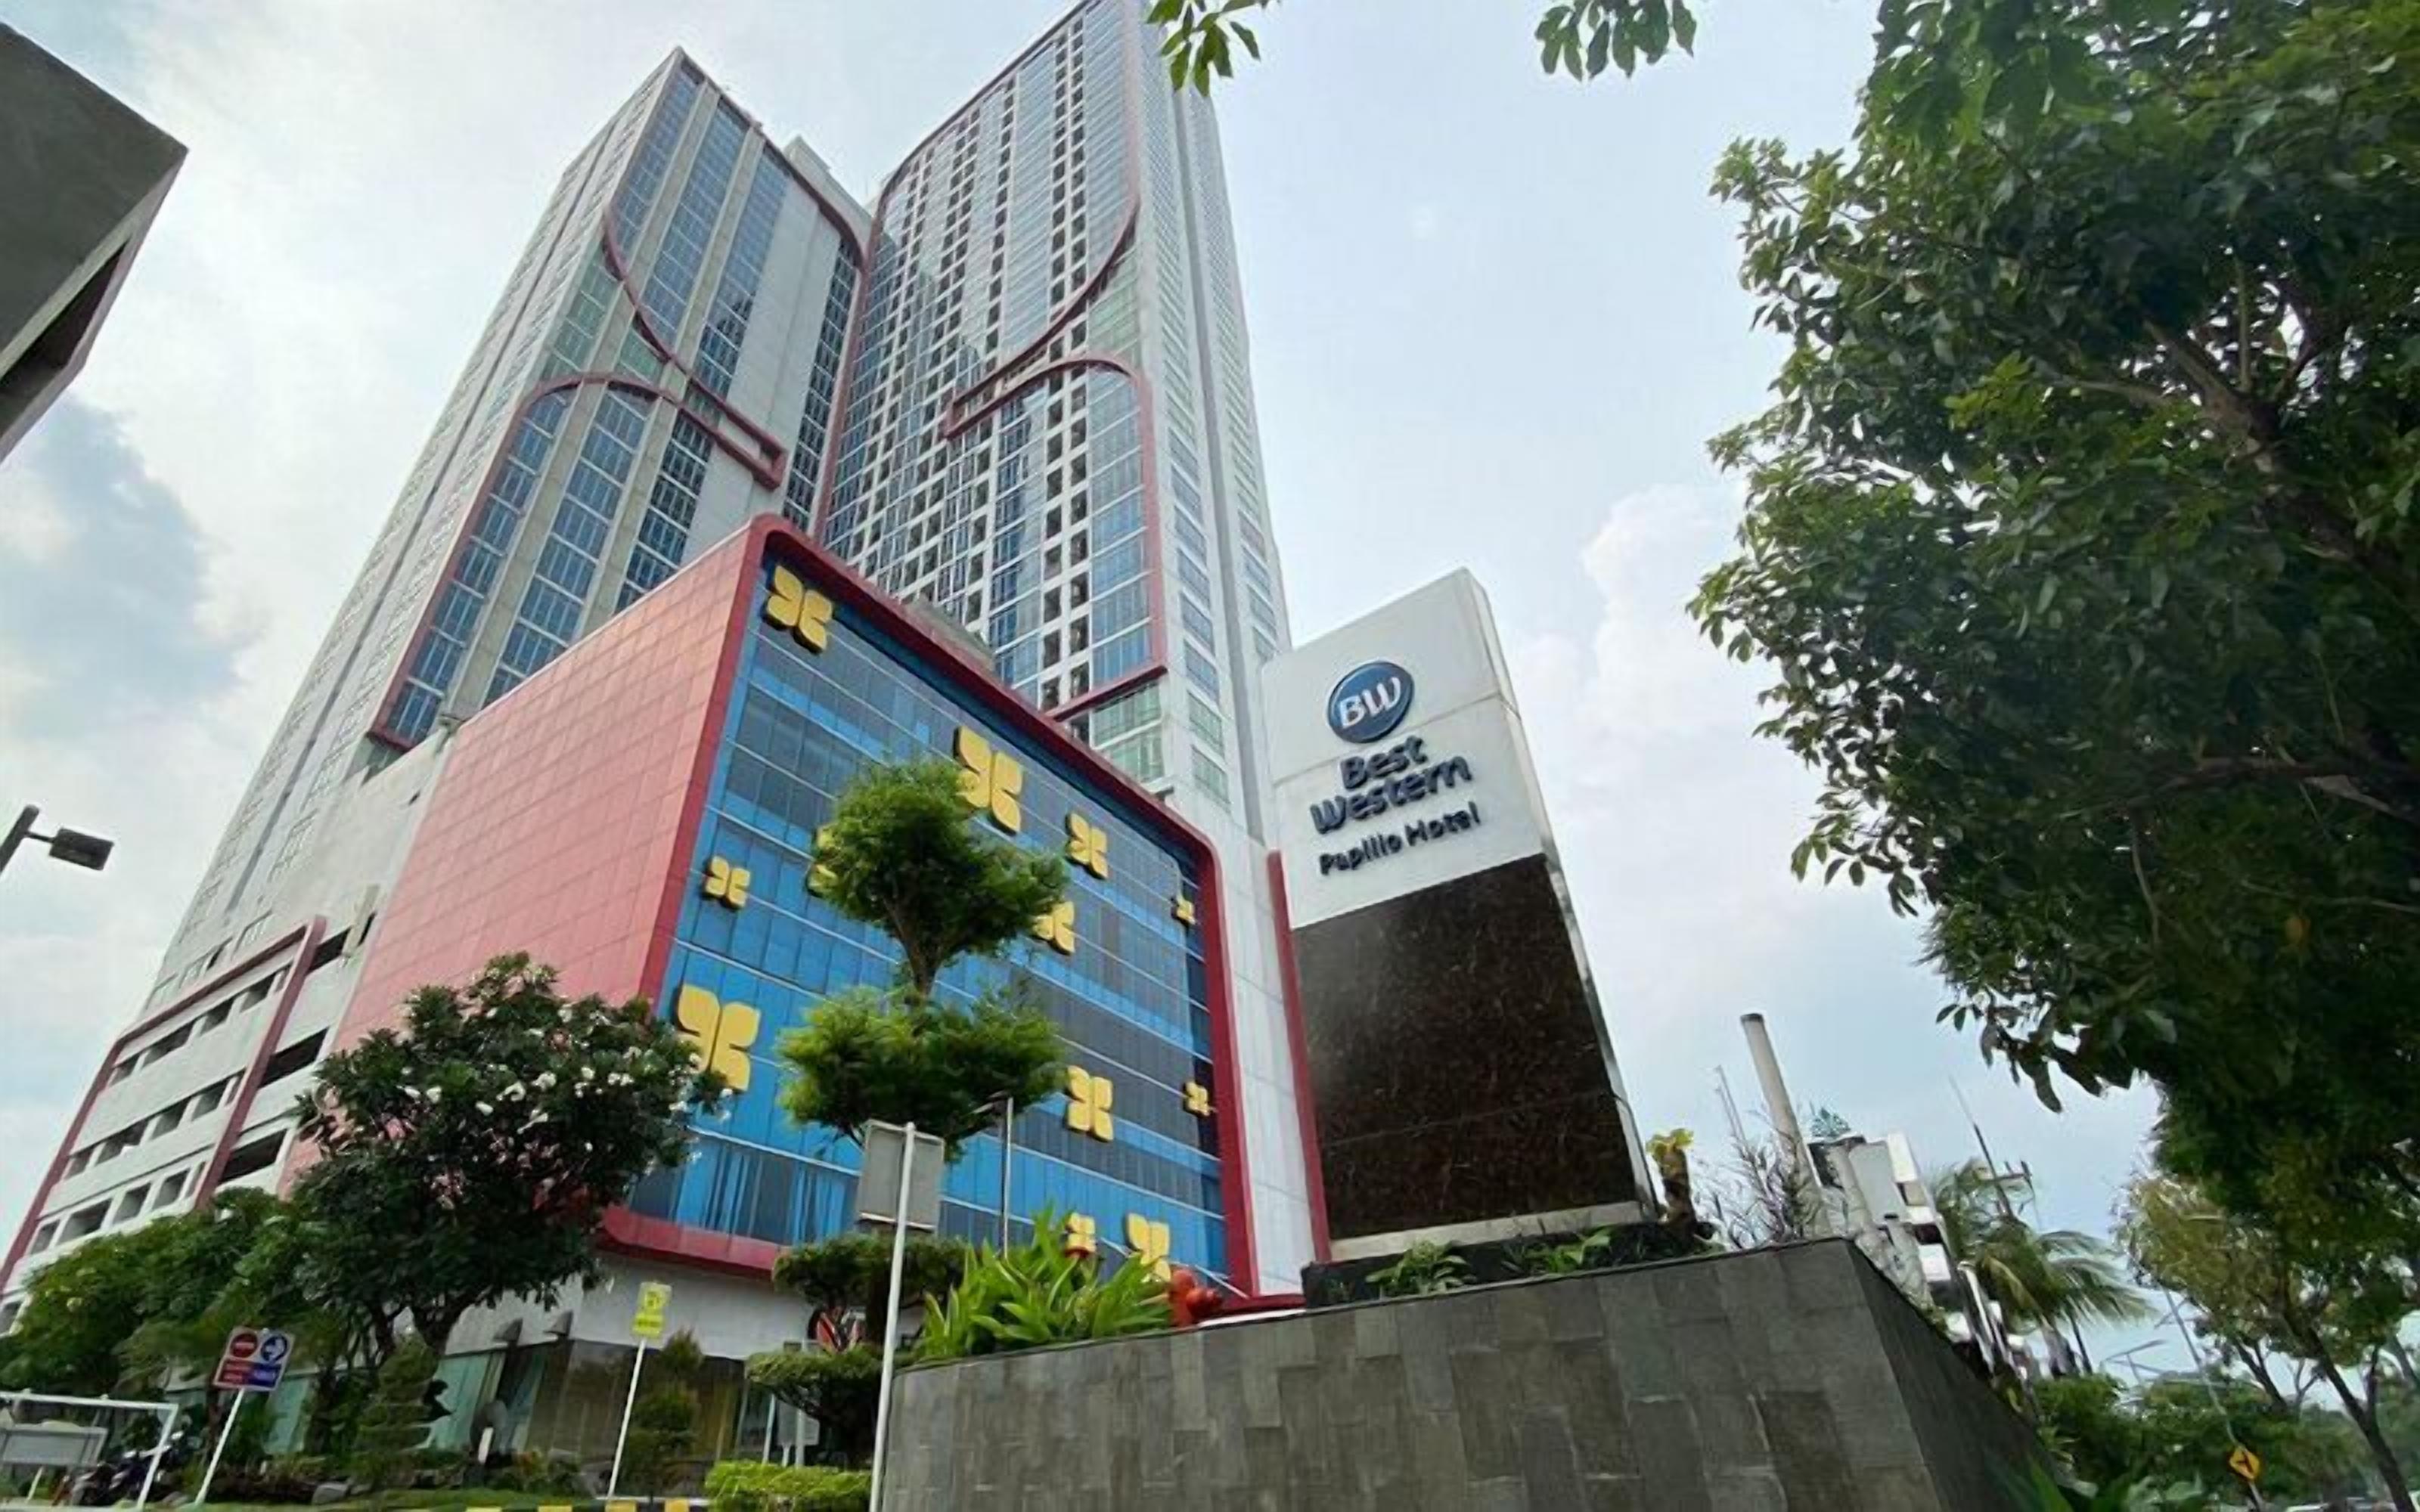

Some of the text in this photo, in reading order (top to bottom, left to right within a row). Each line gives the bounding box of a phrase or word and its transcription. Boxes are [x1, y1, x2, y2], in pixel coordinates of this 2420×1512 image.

[1339, 676, 1401, 729] BW
[1339, 735, 1428, 789] Best
[1310, 756, 1472, 834] Western
[1319, 801, 1481, 875] Papilio Hotel
